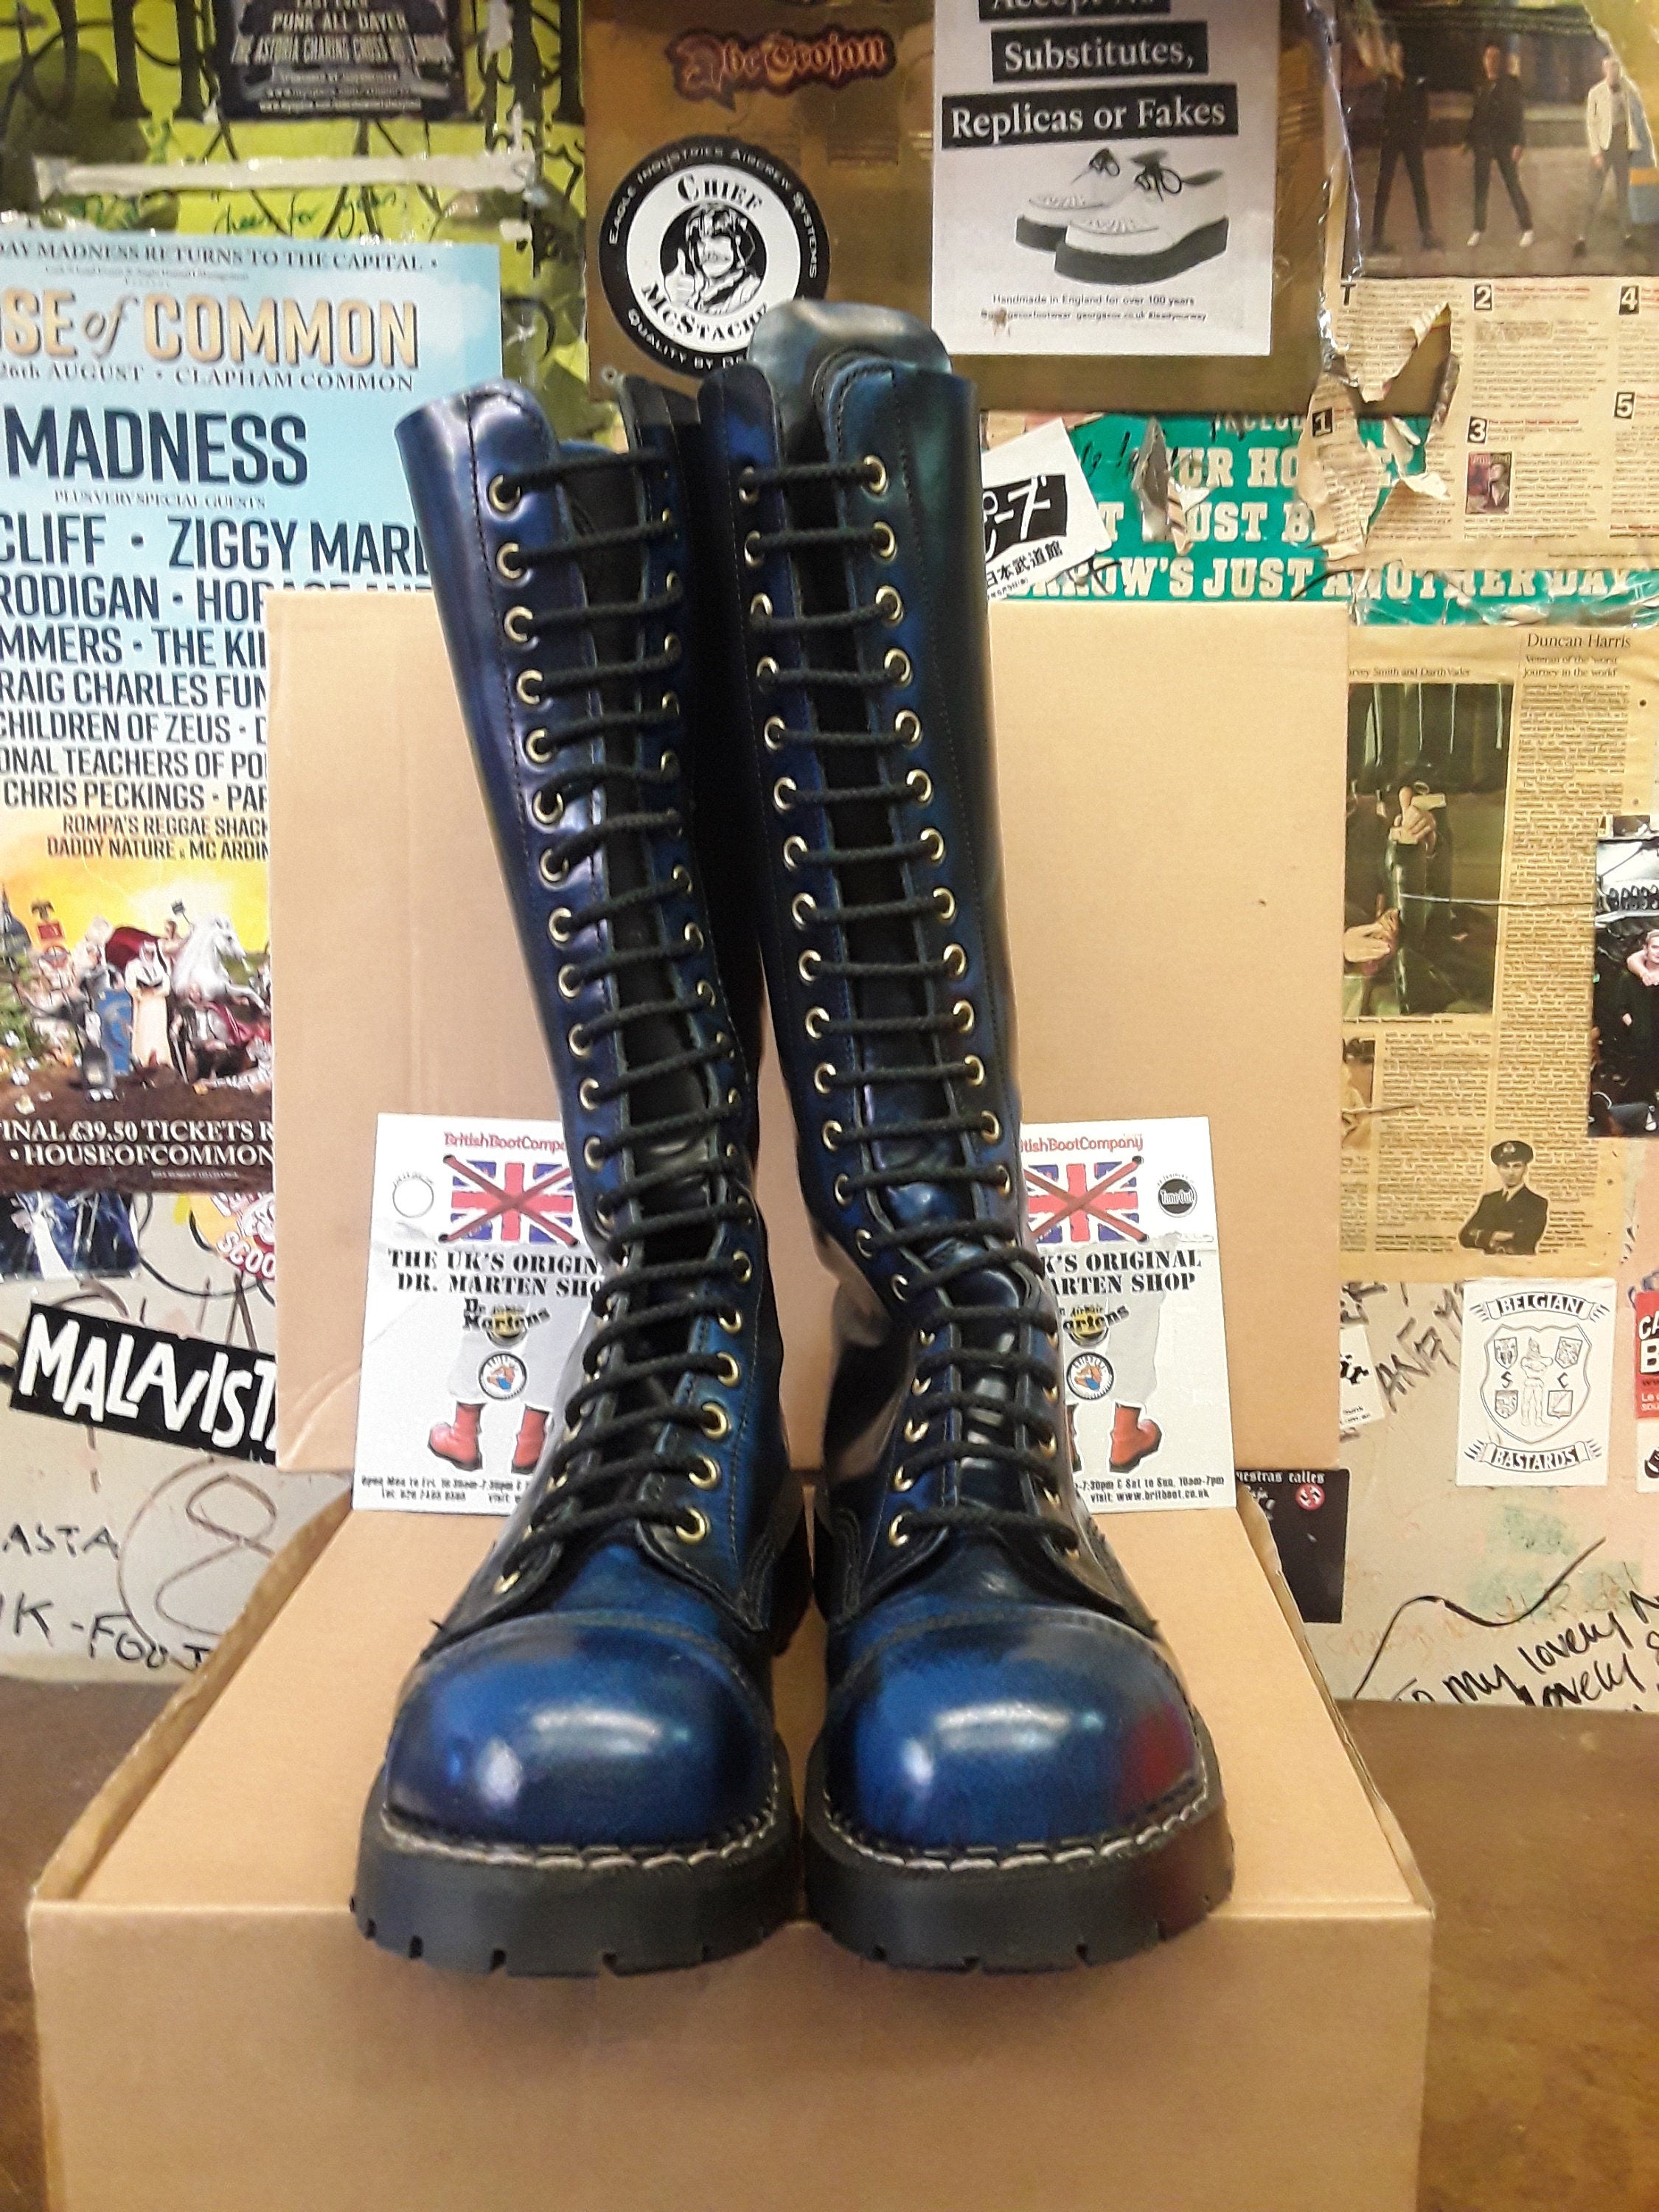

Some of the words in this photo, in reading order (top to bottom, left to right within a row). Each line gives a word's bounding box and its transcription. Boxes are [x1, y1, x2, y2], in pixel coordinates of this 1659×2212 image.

[1005, 38, 1194, 72] Substitutes,
[951, 102, 1083, 143] Replicas
[1094, 106, 1128, 131] or
[1138, 97, 1226, 128] Fakes
[0, 242, 29, 257] AY
[38, 244, 139, 259] MADNESS
[145, 246, 243, 264] RETURNS
[251, 248, 278, 266] TO
[288, 248, 324, 268] THE
[333, 251, 422, 271] CAPITAL
[1148, 294, 1166, 304] 100
[1475, 285, 1492, 310] 2
[1621, 288, 1638, 311] 4
[0, 288, 77, 359] SE
[83, 296, 140, 359] of
[145, 293, 420, 369] COMMON
[48, 363, 144, 382] AUGUST
[175, 367, 293, 389] CLAPHAM
[299, 373, 414, 392] COMMON
[1615, 393, 1634, 418] 5
[1313, 409, 1332, 436] 1
[1469, 418, 1486, 442] 3
[2, 405, 308, 487] MADNESS
[1166, 447, 1234, 487] UR
[1186, 501, 1268, 542] UST
[168, 516, 298, 573] ZIGGY
[1203, 557, 1314, 598] JUST
[152, 627, 215, 667] THE
[1526, 633, 1582, 648] Duncan
[1587, 632, 1632, 649] Harris
[1373, 666, 1399, 676] Smith
[1402, 667, 1418, 676] and
[1562, 667, 1571, 676] in
[1573, 667, 1588, 676] the
[74, 669, 209, 708] CHARLES
[128, 712, 159, 744] OF
[164, 712, 231, 745] ZEUS
[63, 746, 189, 778] TEACHERS
[195, 750, 224, 779] OF
[231, 751, 267, 780] PO
[4, 778, 77, 809] CHRIS
[84, 779, 205, 811] PECKINGS
[63, 813, 139, 836] ROMPA'S
[144, 814, 211, 838] REGGAE
[46, 835, 104, 858] DADDY
[108, 837, 175, 860] NATURE
[189, 839, 217, 860] MC
[0, 1119, 65, 1142] INAL
[69, 1119, 138, 1143] £39.50
[141, 1119, 255, 1142] TICKETS
[388, 1248, 437, 1269] THE
[447, 1252, 504, 1272] UK'S
[1041, 1253, 1078, 1274] K'S
[1085, 1249, 1203, 1271] ORIGINAL
[398, 1273, 438, 1292] DR.
[449, 1275, 547, 1296] MARTEN
[1131, 1272, 1196, 1292] SHOP
[1500, 1293, 1582, 1315] BELGIAN
[1501, 1371, 1514, 1388] S
[1557, 1372, 1569, 1389] C
[1492, 1447, 1579, 1471] BASTARDS
[1288, 1470, 1326, 1484] calles
[1517, 1610, 1634, 1675] lovely
